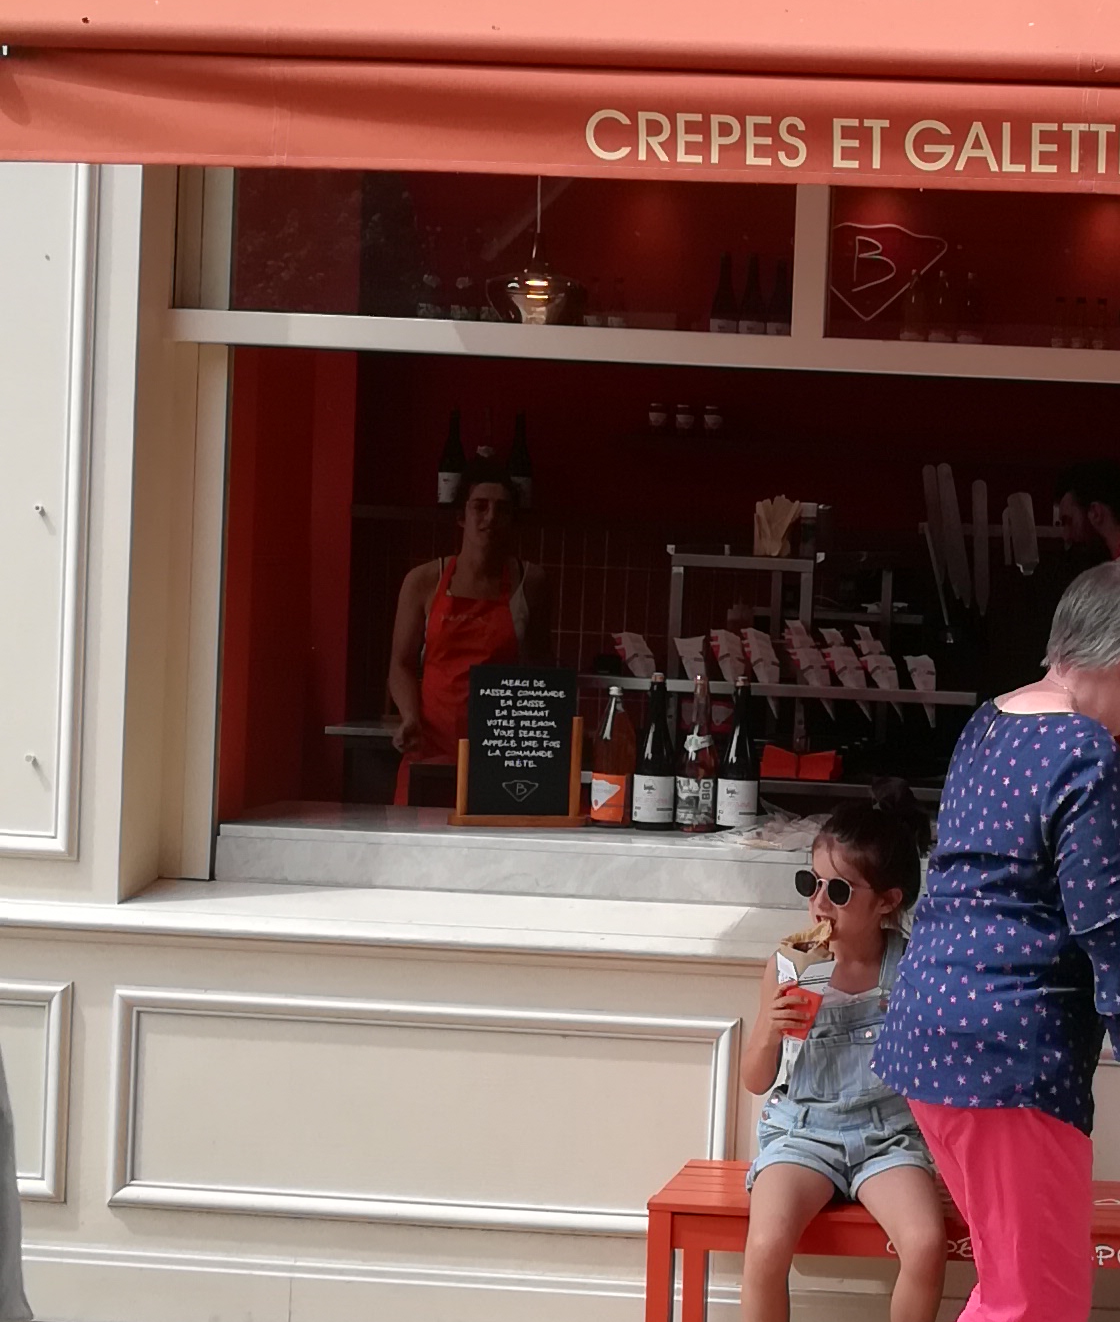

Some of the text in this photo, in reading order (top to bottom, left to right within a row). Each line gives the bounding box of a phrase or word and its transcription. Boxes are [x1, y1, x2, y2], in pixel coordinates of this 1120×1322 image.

[586, 109, 807, 168] CREPES
[832, 117, 890, 170] ET
[852, 236, 897, 292] B
[500, 679, 546, 688] MERCI DE
[480, 689, 566, 698] PASSER COMMANDE
[500, 699, 546, 708] EN CAISSE
[495, 709, 550, 718] EN DONNANT
[486, 719, 515, 727] VOTRE
[493, 728, 550, 738] VOUS SEREZ
[521, 739, 539, 748] UNE
[543, 740, 561, 749] FOIS
[487, 749, 554, 758] LA COMMANDE
[701, 781, 712, 801] BIO
